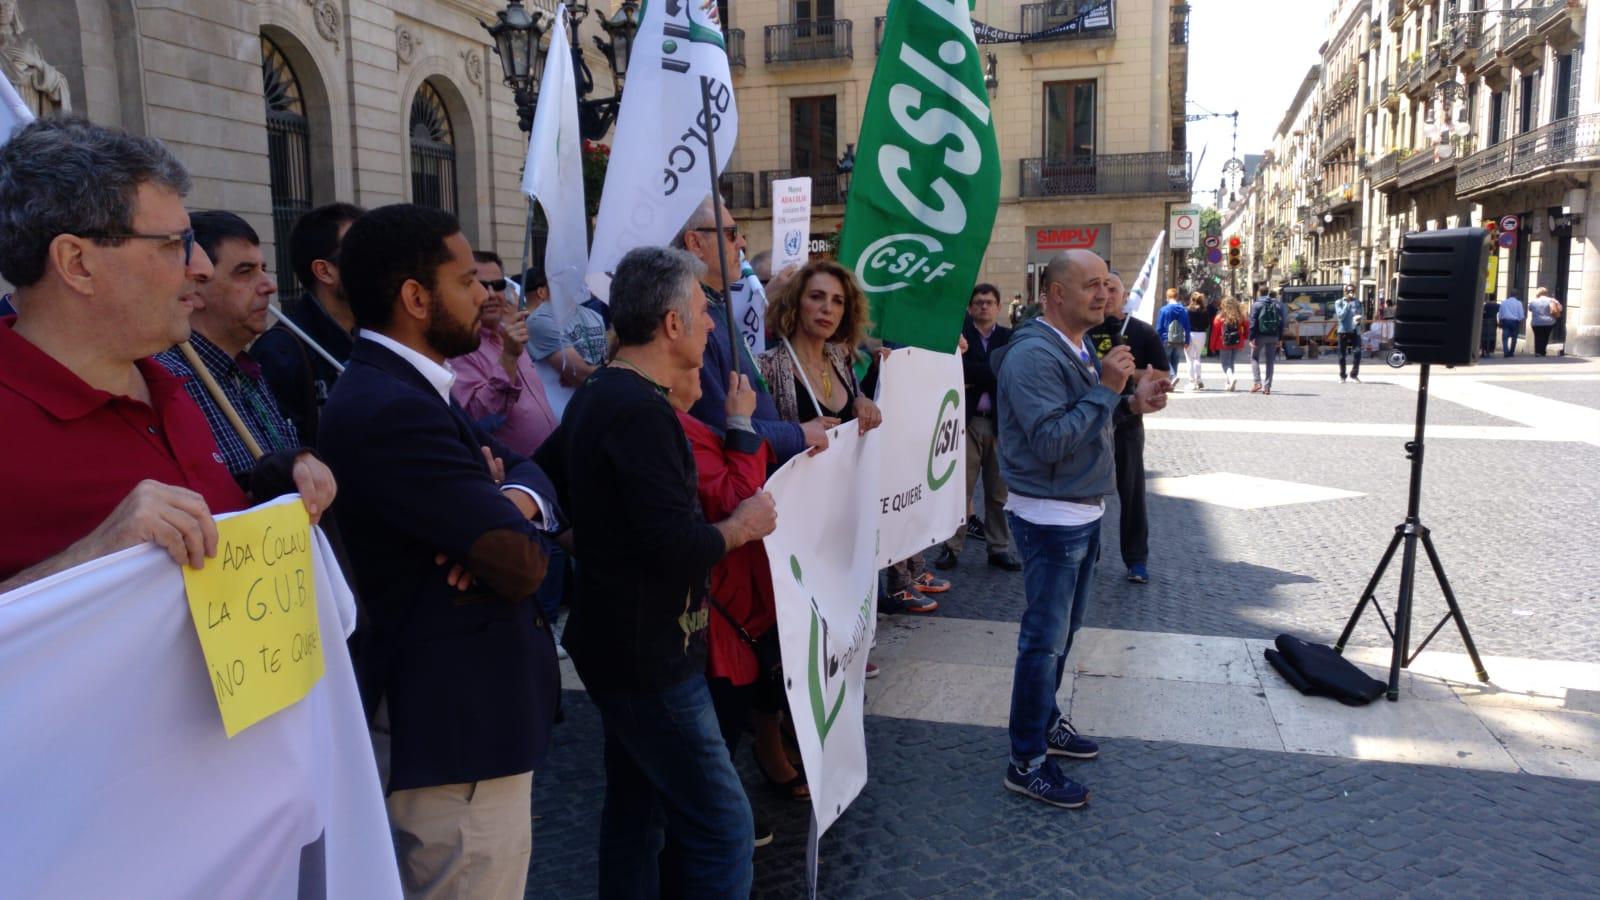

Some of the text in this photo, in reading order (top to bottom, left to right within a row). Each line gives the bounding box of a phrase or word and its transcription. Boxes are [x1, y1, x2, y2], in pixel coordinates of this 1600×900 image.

[892, 483, 922, 513] QUIERE
[222, 540, 255, 571] ADA
[208, 601, 231, 629] LA
[259, 644, 281, 673] TE
